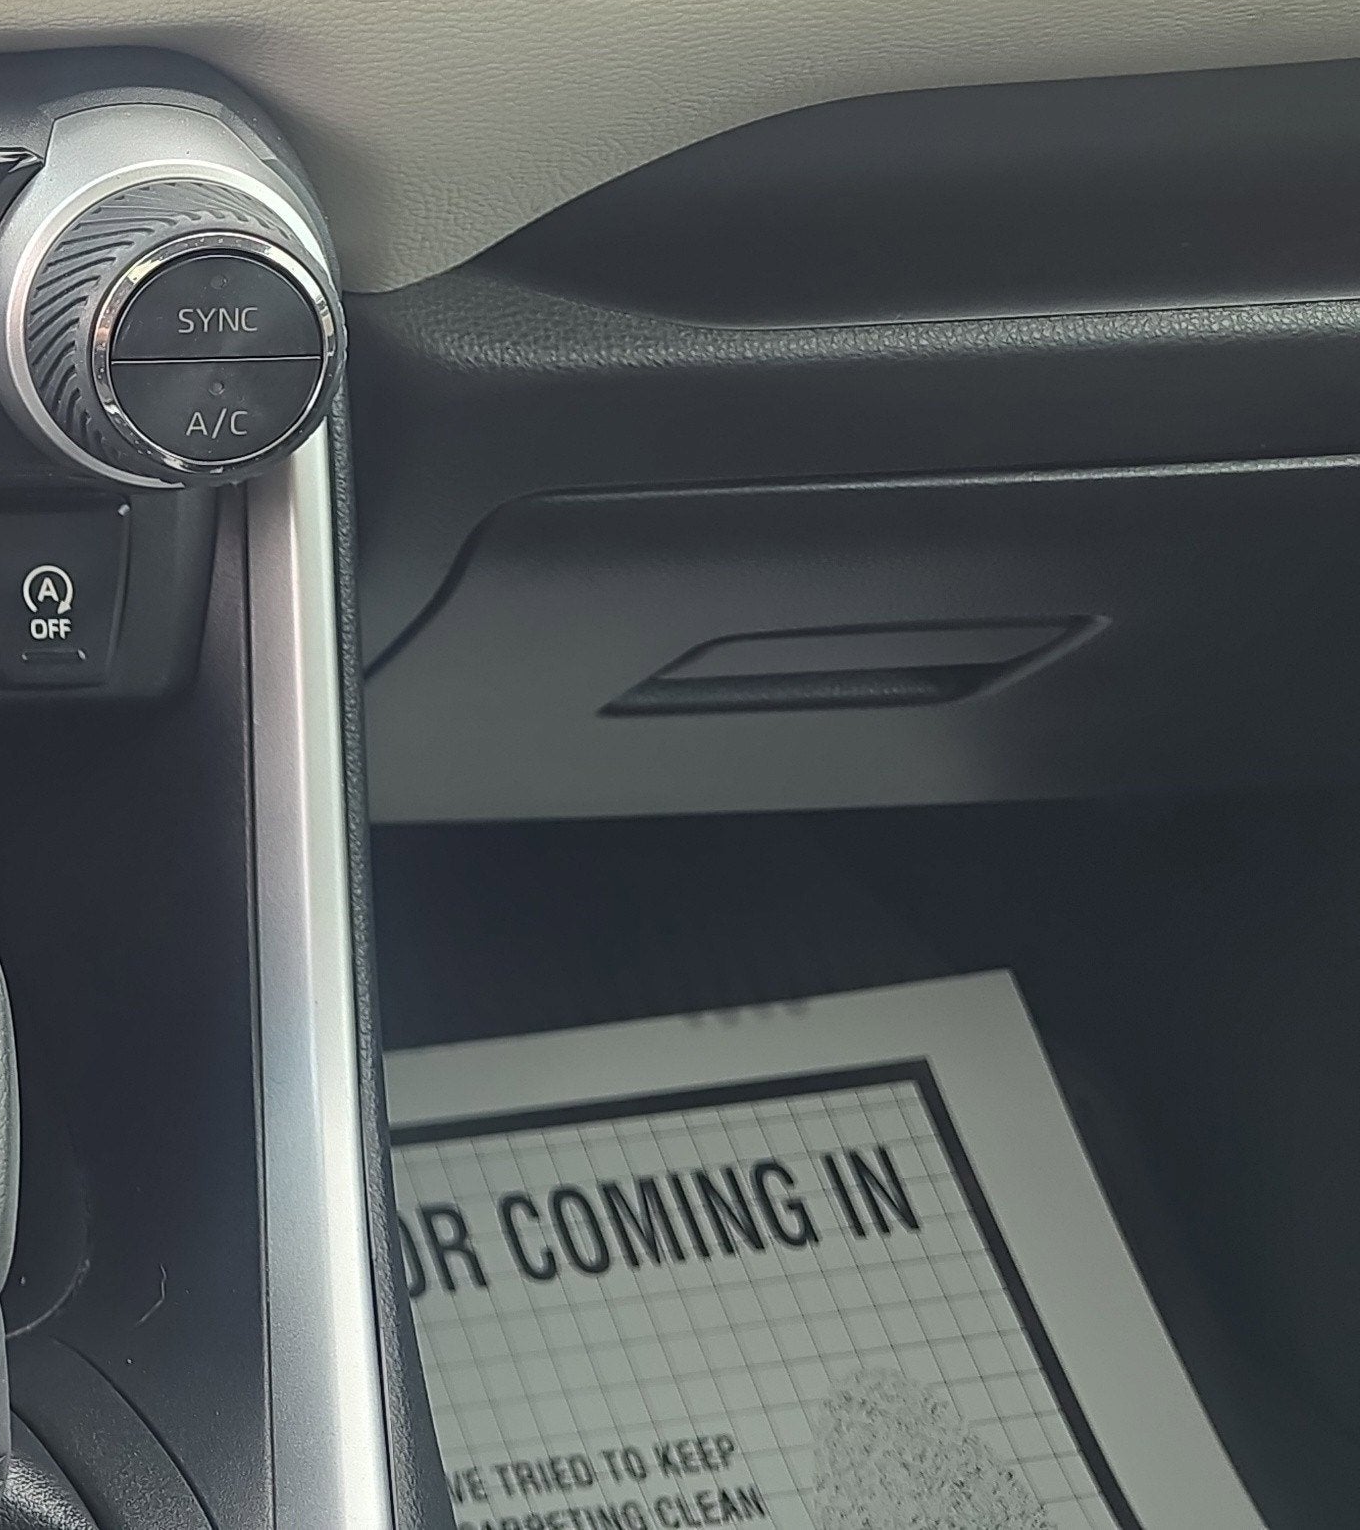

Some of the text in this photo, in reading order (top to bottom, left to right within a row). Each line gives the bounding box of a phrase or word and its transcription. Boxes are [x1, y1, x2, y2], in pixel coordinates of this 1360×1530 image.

[178, 307, 258, 333] SYNC
[185, 408, 248, 439] A/C
[30, 618, 71, 639] OFF
[500, 1156, 820, 1286] COMING
[824, 1142, 922, 1238] IN
[491, 1453, 594, 1498] TRIED
[600, 1445, 648, 1486] TO
[651, 1432, 734, 1478] KEEP
[653, 1483, 767, 1530] CLEAN
